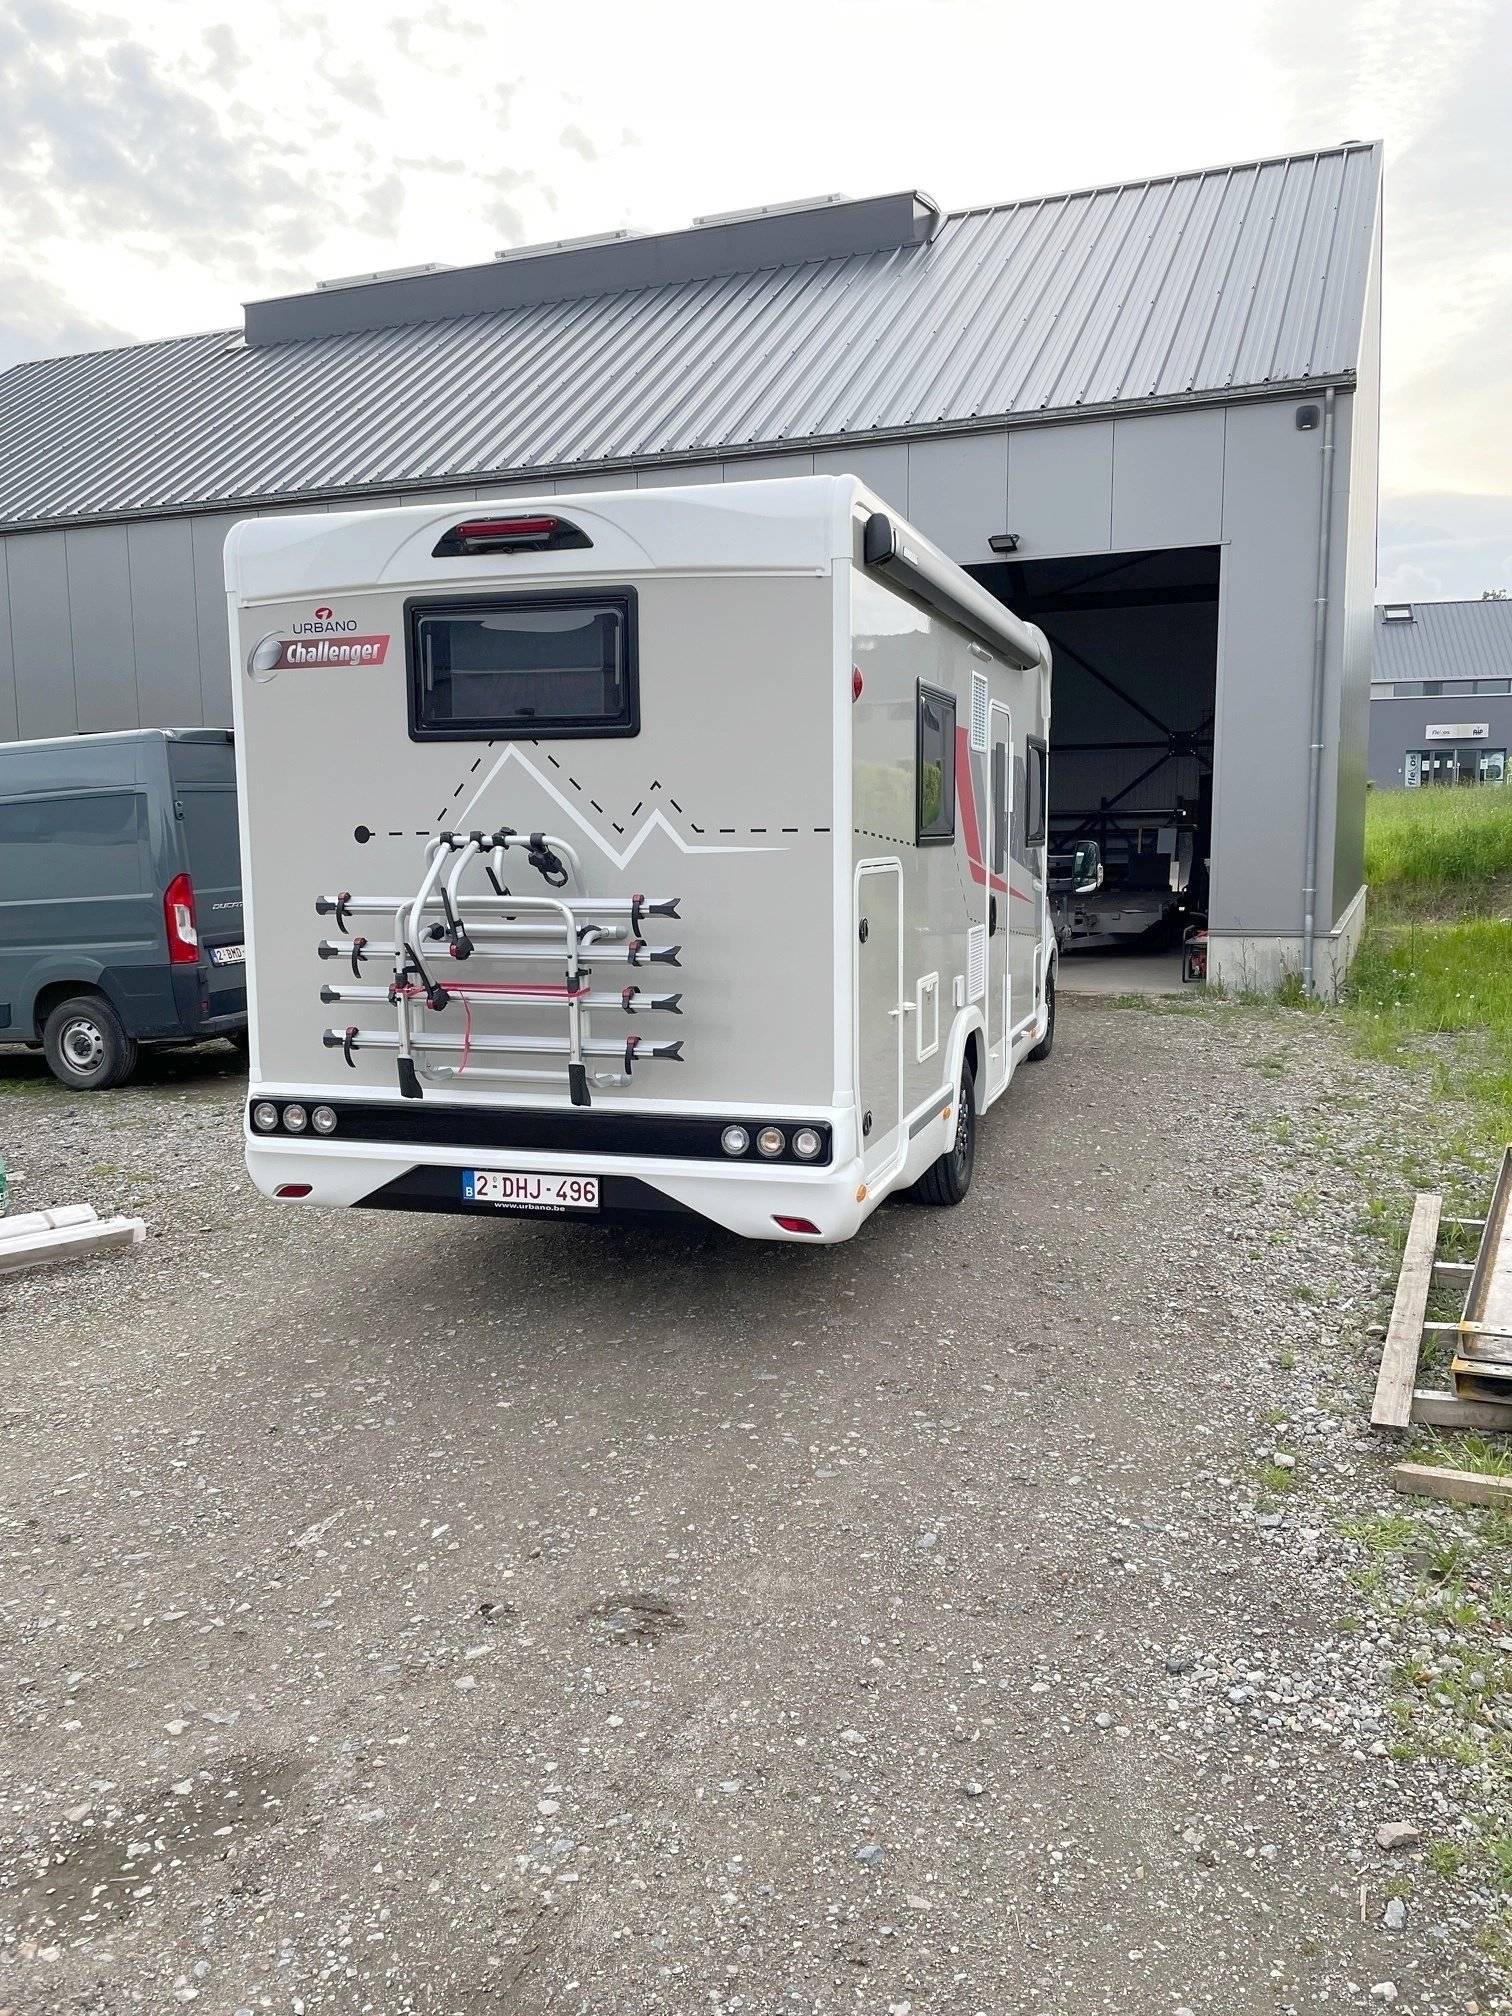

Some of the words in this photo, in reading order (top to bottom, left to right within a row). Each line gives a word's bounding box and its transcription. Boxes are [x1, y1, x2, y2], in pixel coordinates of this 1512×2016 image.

[293, 620, 357, 634] URBANO
[287, 641, 380, 665] Challenger
[465, 1186, 473, 1197] B
[477, 1176, 595, 1202] 2-DHJ-496
[494, 1201, 565, 1212] www.urbano.be
